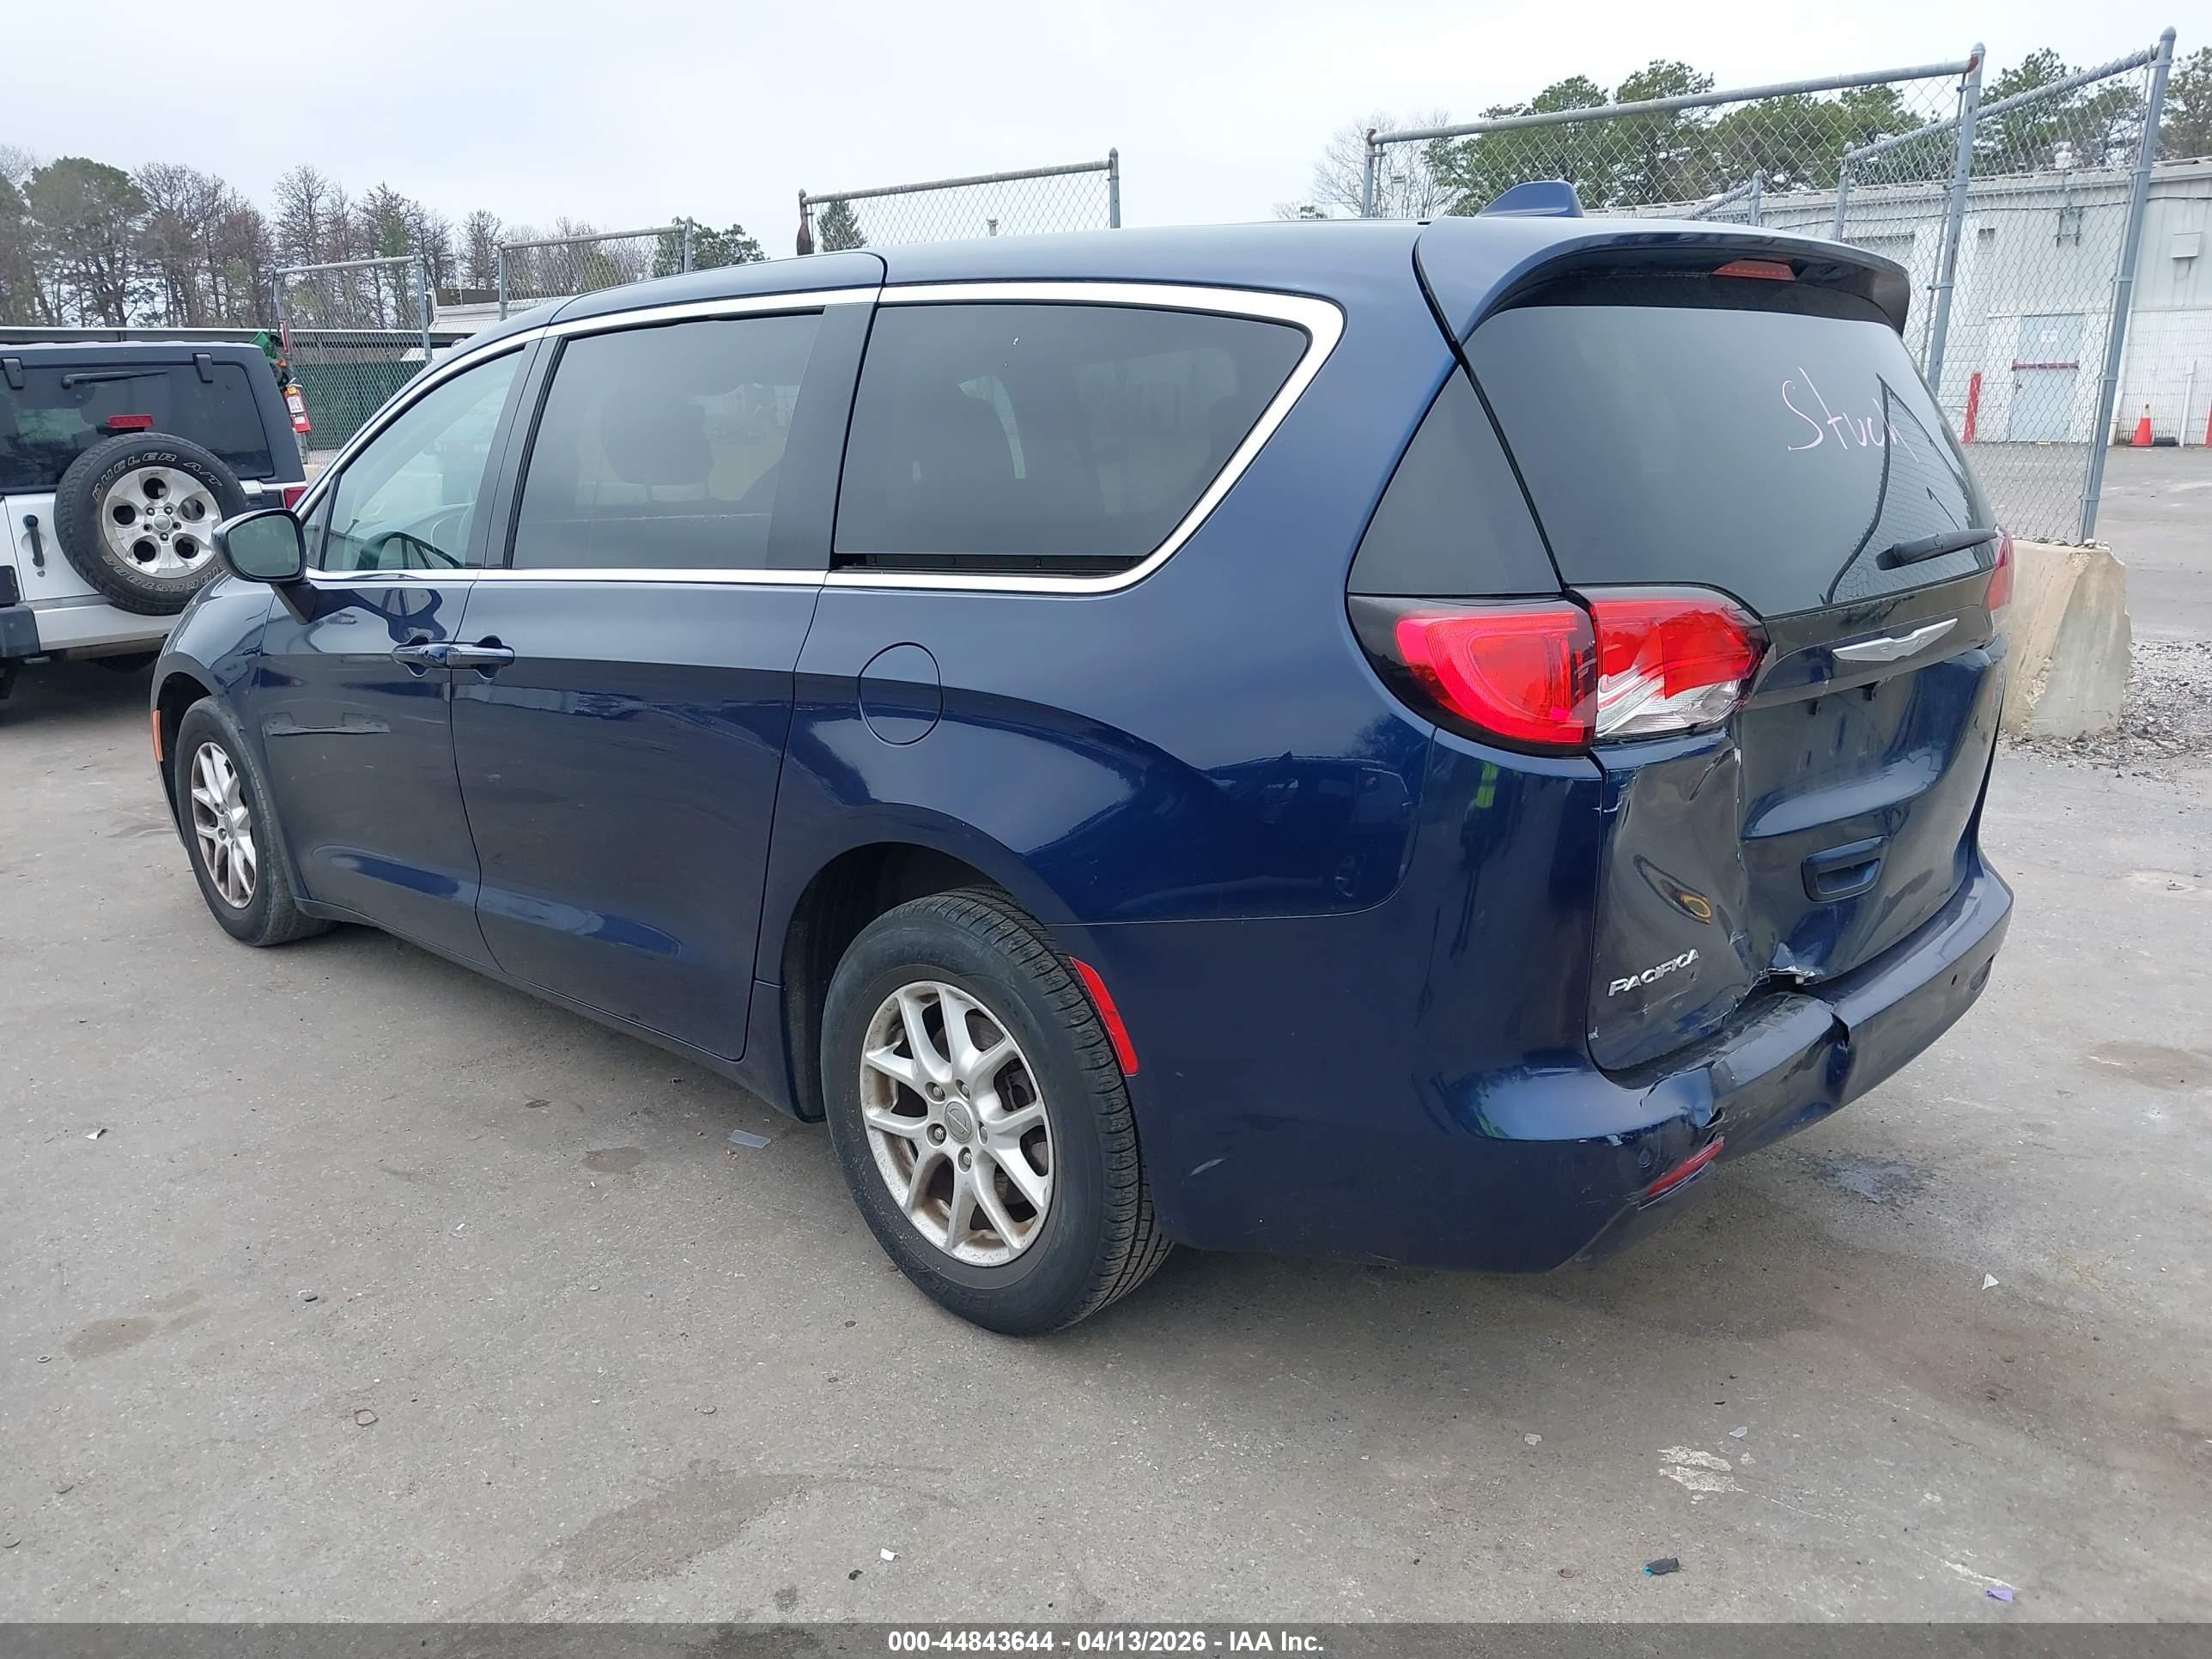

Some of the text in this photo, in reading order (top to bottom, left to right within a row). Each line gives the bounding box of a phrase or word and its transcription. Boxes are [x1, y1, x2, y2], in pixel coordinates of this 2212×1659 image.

[92, 453, 223, 501] DUELER A/T
[1607, 948, 1699, 997] PACIFICA
